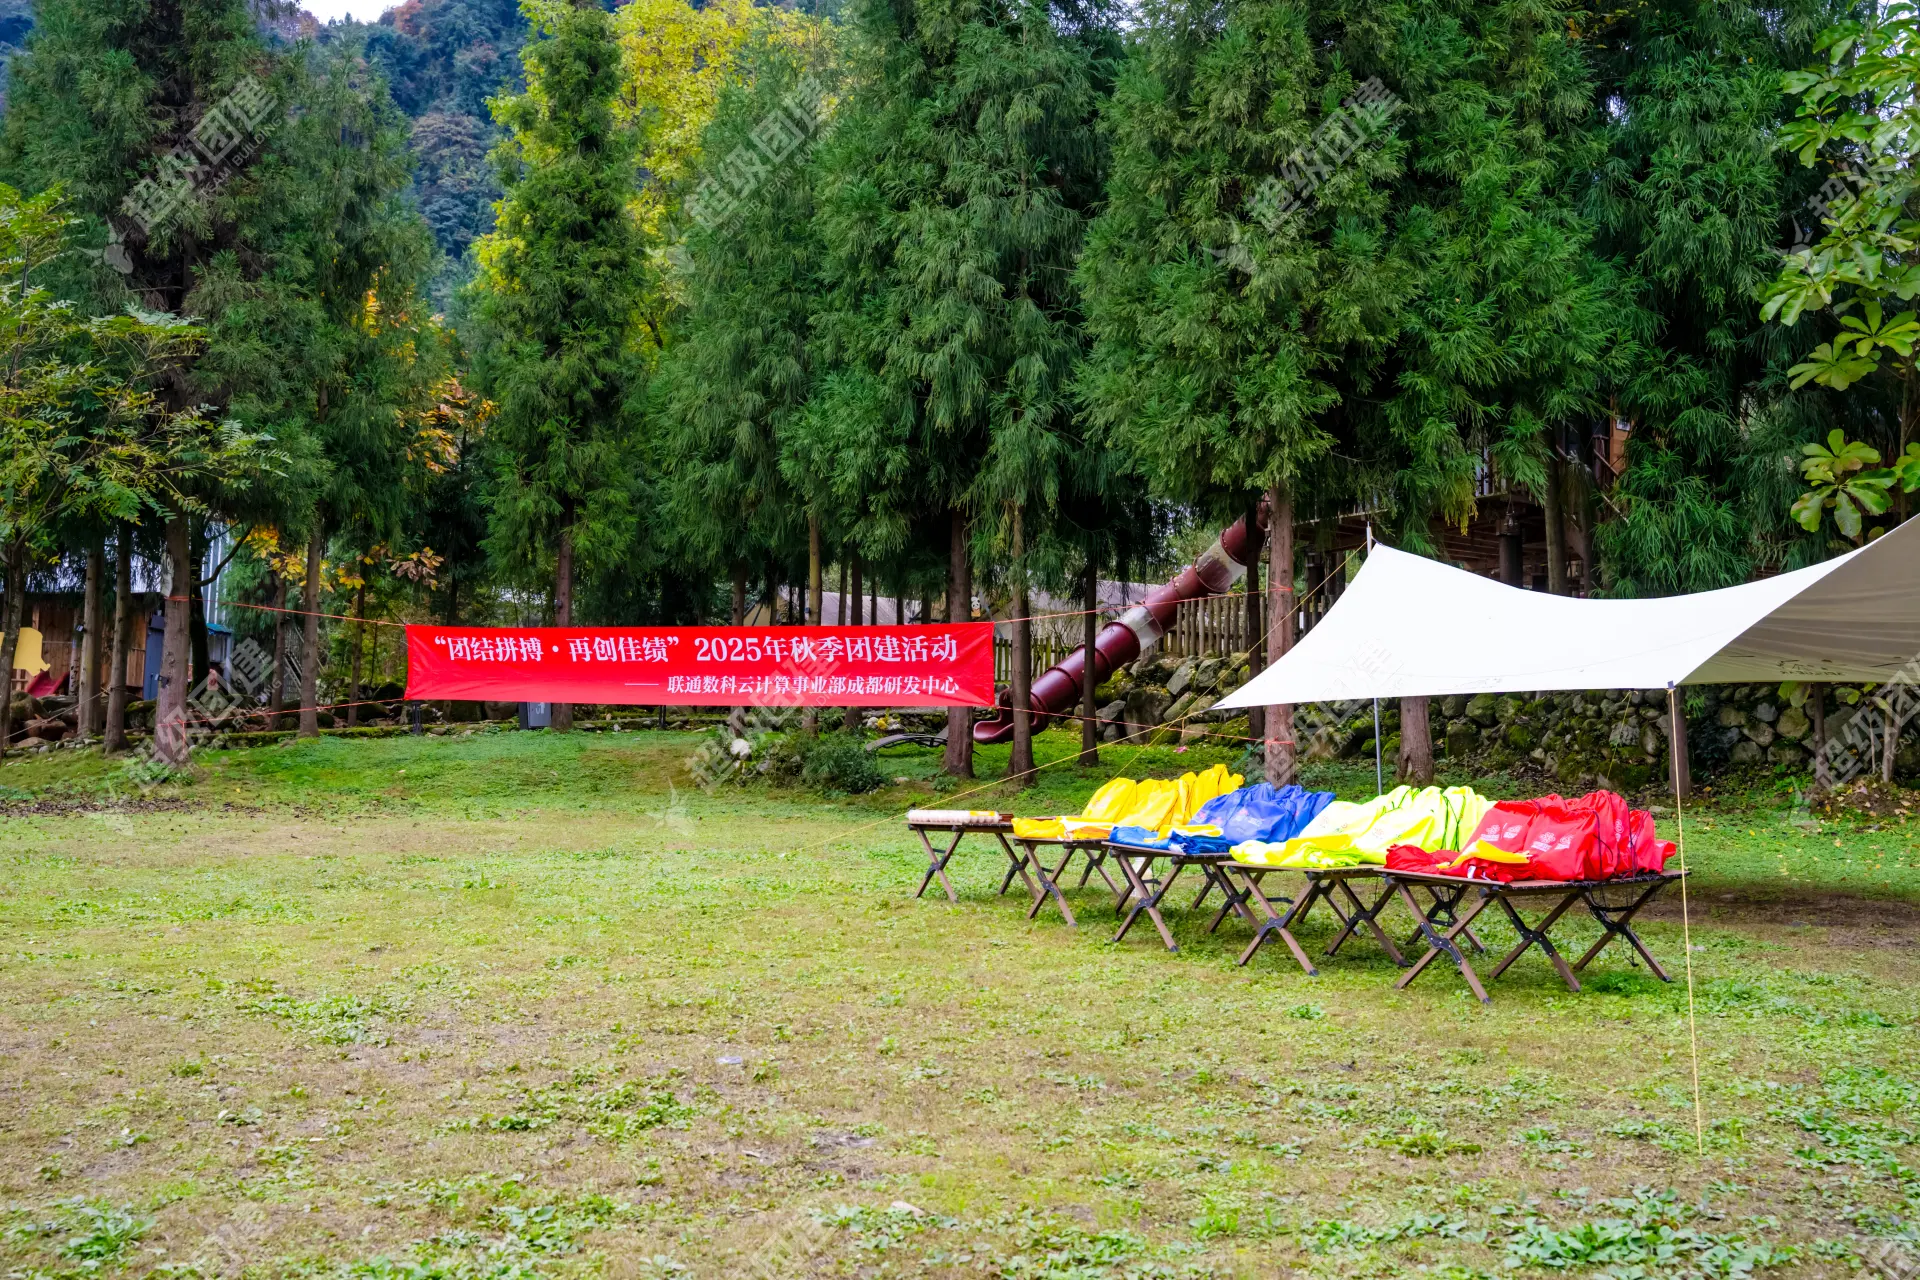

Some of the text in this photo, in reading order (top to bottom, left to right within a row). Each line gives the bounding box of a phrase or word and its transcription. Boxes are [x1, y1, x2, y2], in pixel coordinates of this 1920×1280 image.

[694, 633, 957, 663] 2025年秋季团建活动
[667, 674, 960, 696] 联通数科云计算事业部成都研发中心
